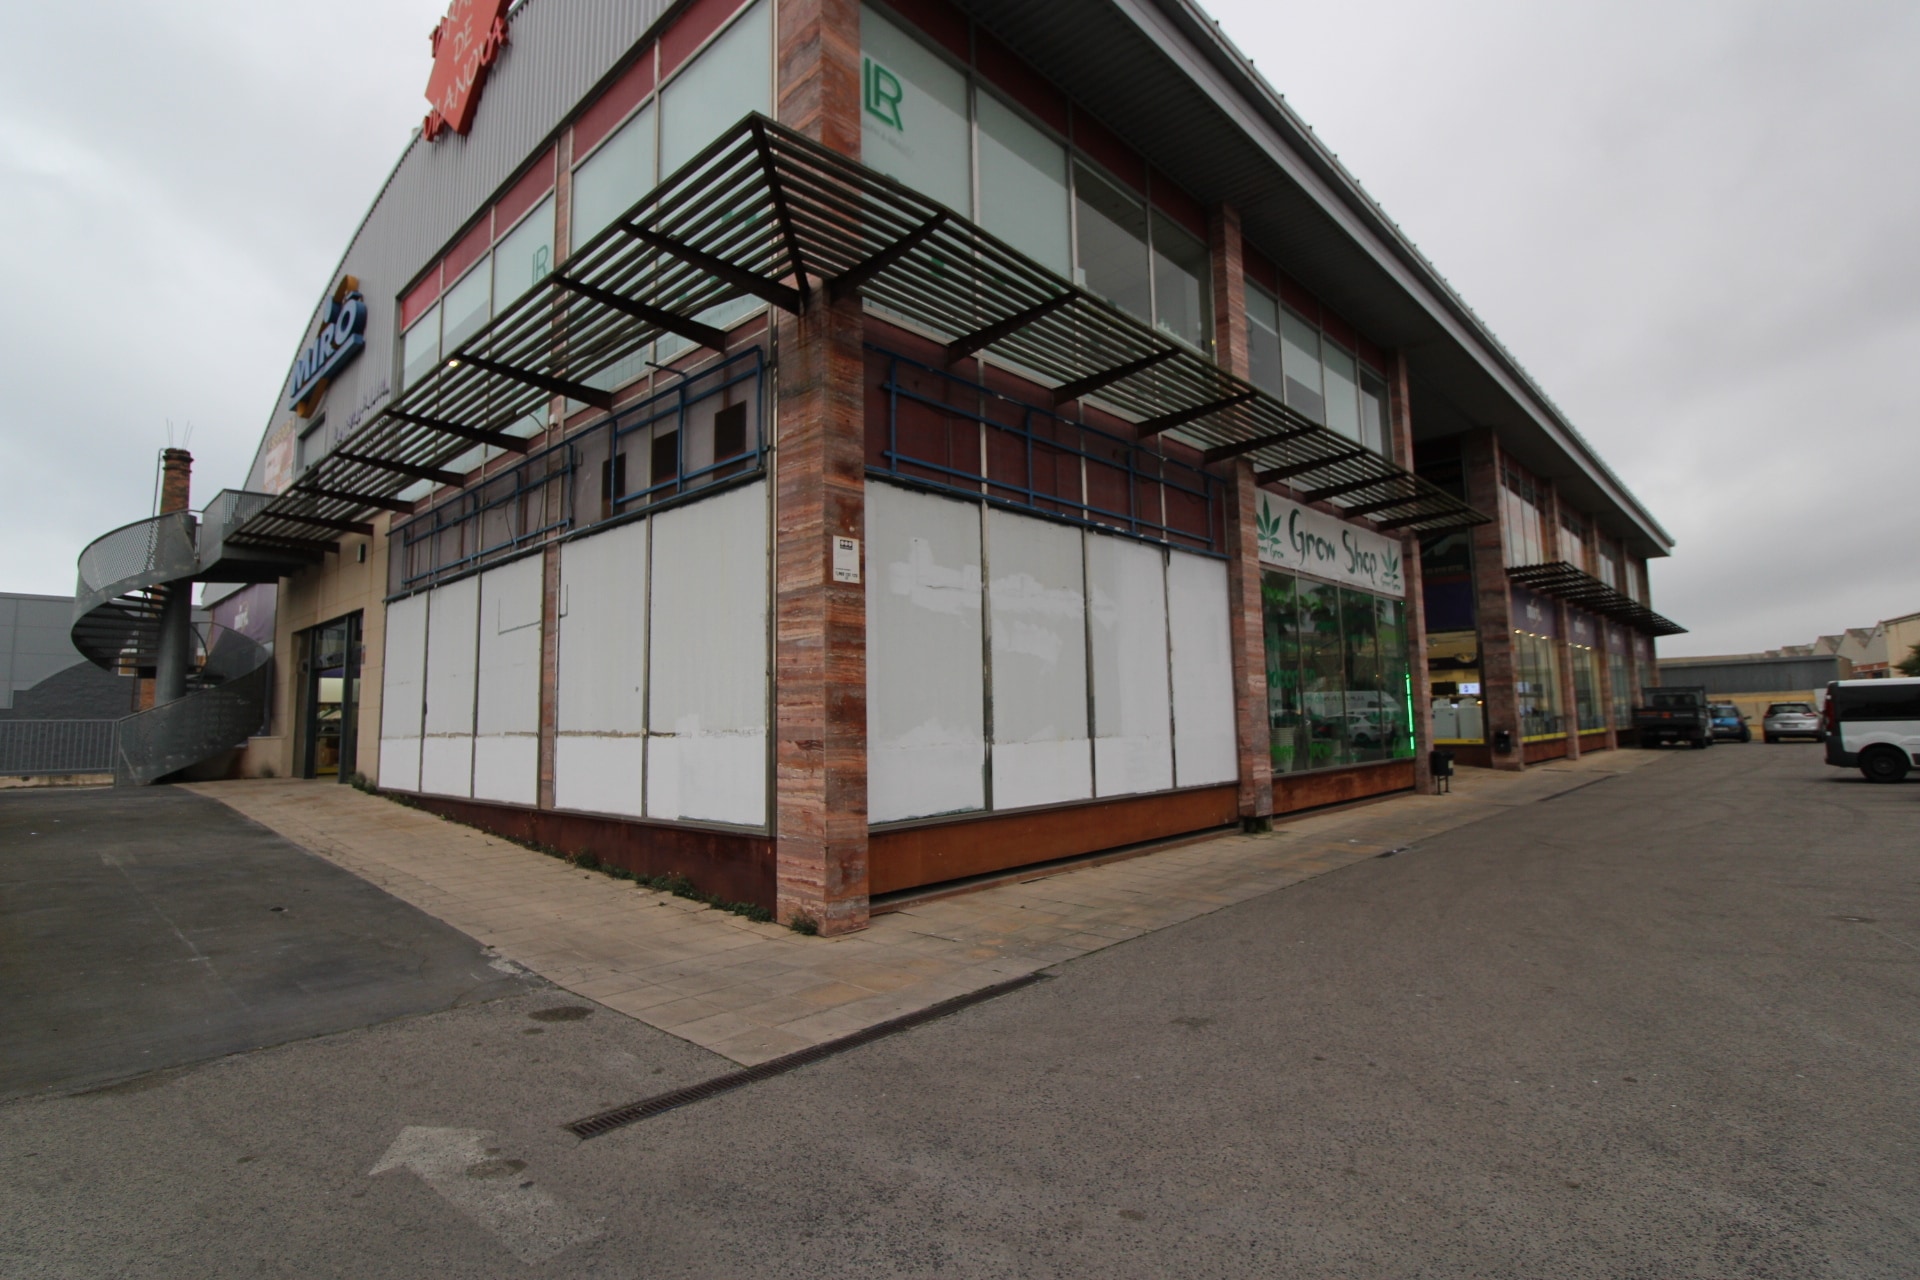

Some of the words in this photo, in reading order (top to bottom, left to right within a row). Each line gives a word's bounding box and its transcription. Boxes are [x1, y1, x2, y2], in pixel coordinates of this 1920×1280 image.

[454, 13, 473, 63] DE
[864, 57, 904, 132] LR
[1288, 508, 1336, 567] Grow
[1342, 529, 1378, 586] Shop
